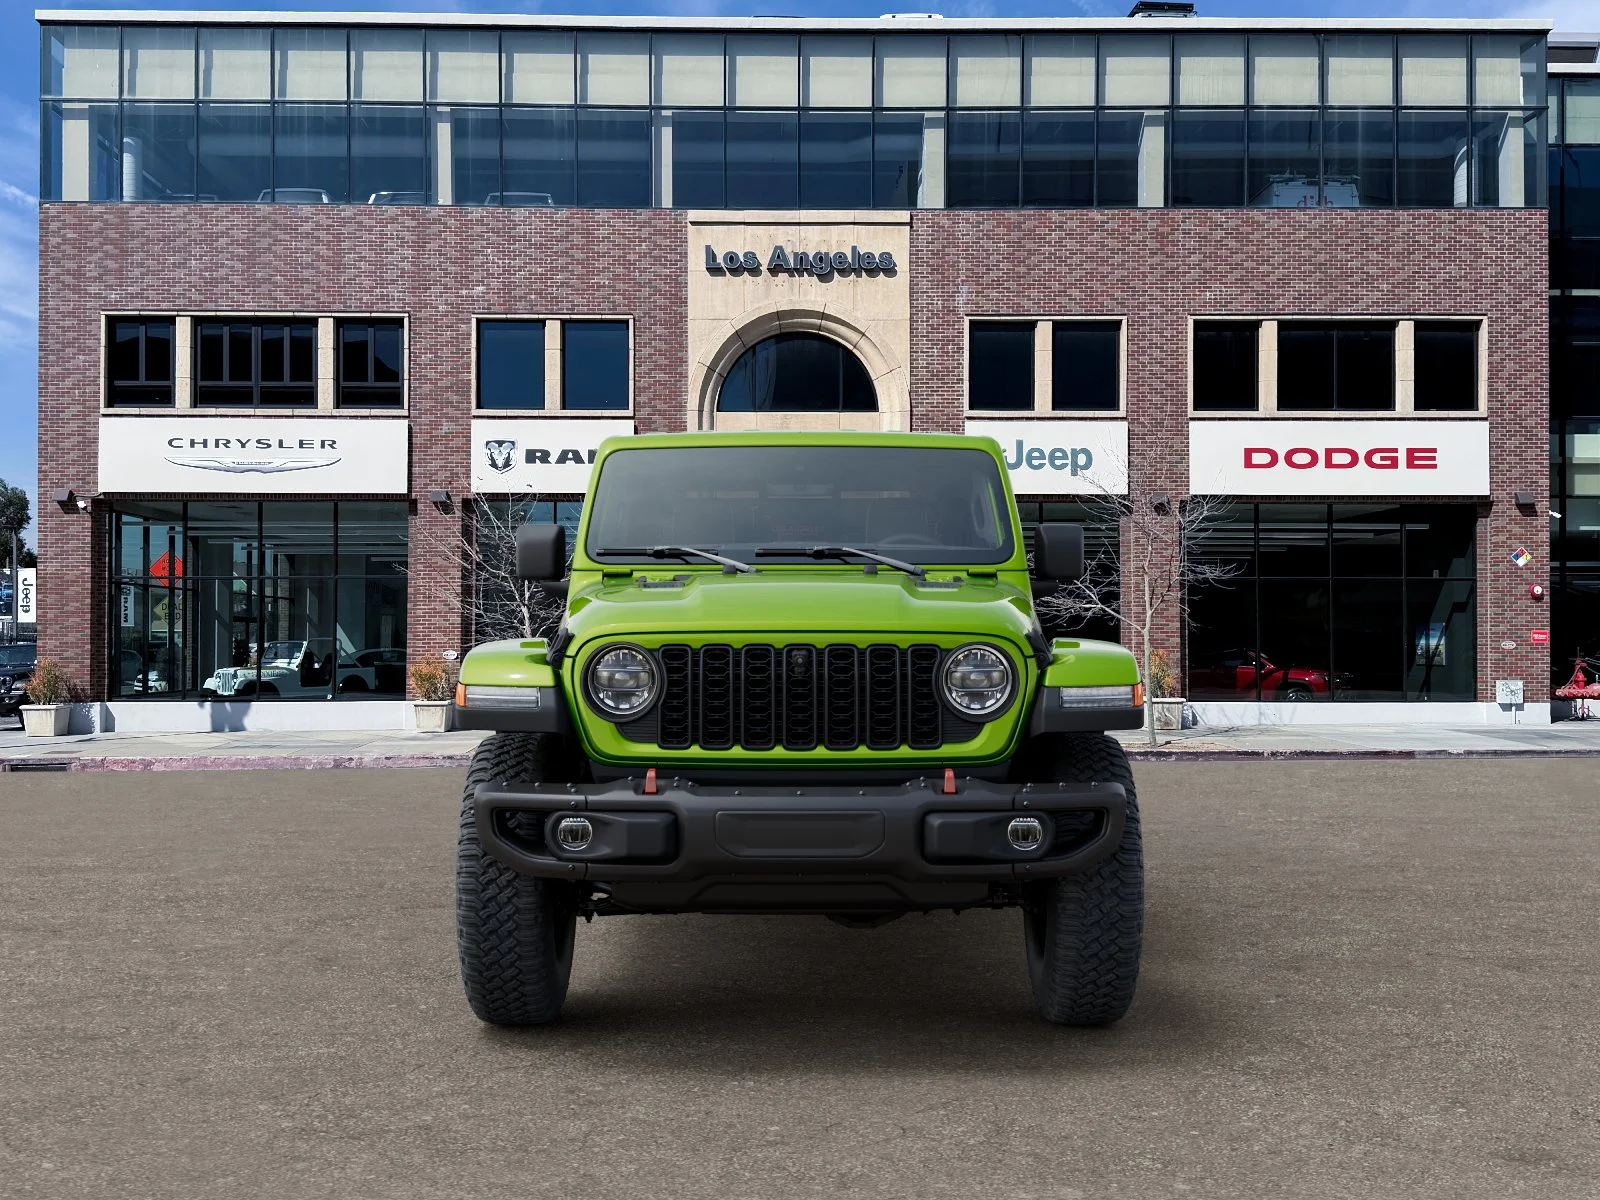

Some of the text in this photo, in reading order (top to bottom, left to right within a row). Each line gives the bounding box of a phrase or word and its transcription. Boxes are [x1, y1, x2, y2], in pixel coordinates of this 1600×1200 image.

[705, 245, 894, 274] Los Angeles
[167, 438, 338, 449] CHRYSLER
[1005, 439, 1093, 476] Jeep
[1244, 447, 1438, 469] DODGE
[20, 578, 33, 613] Jeep
